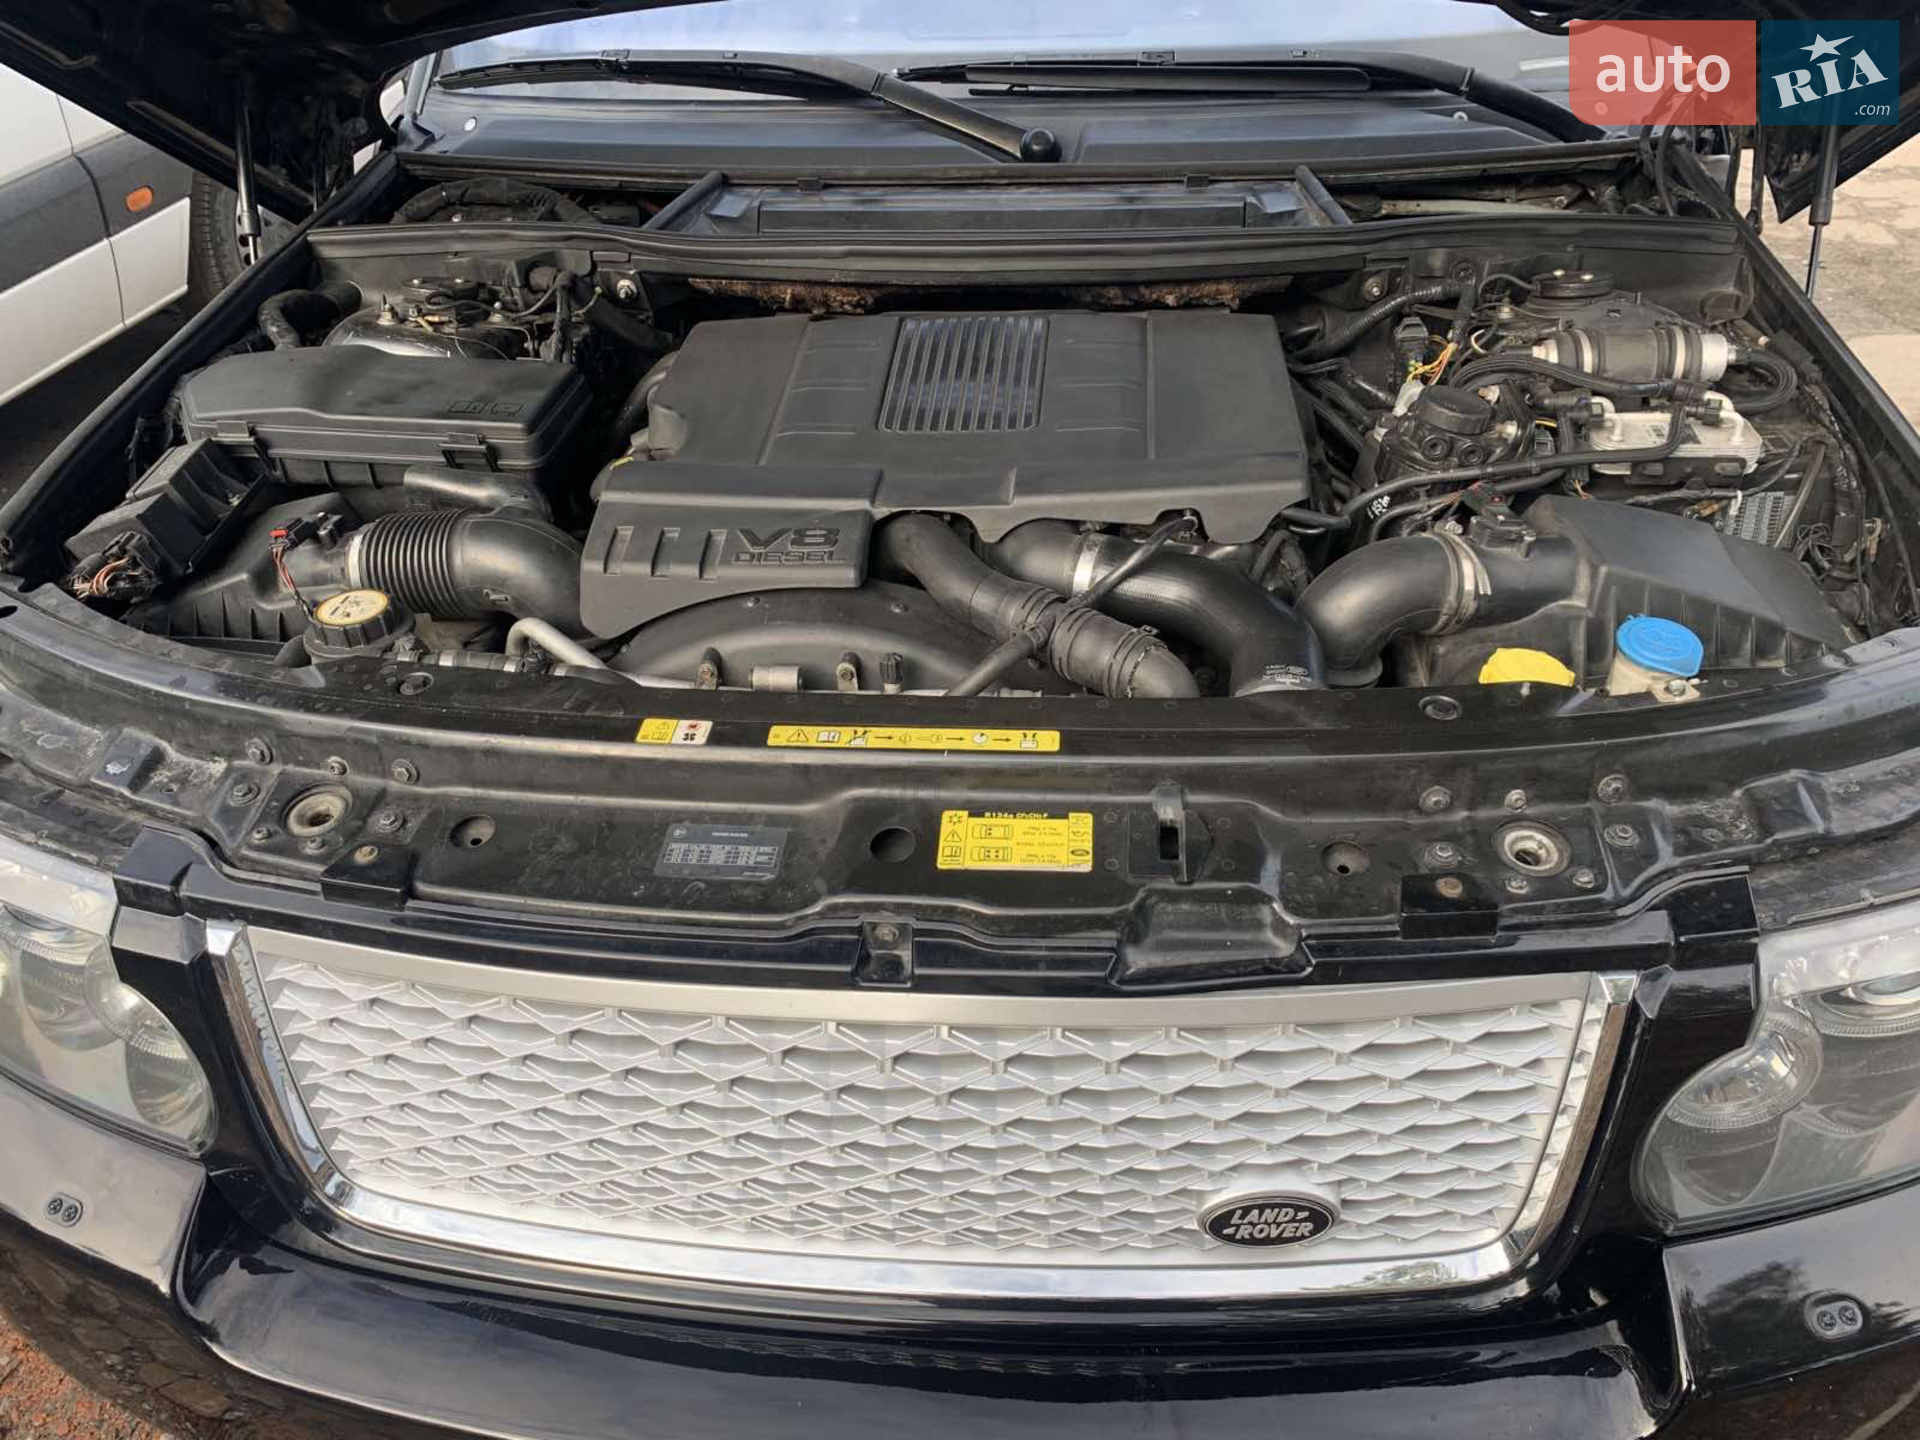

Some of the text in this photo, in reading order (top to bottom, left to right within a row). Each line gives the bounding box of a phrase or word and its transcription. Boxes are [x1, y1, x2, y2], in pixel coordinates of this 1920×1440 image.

[737, 526, 841, 552] V8
[731, 551, 846, 566] DIESEL
[1230, 1207, 1295, 1224] LAND
[1235, 1222, 1314, 1239] ROVER
